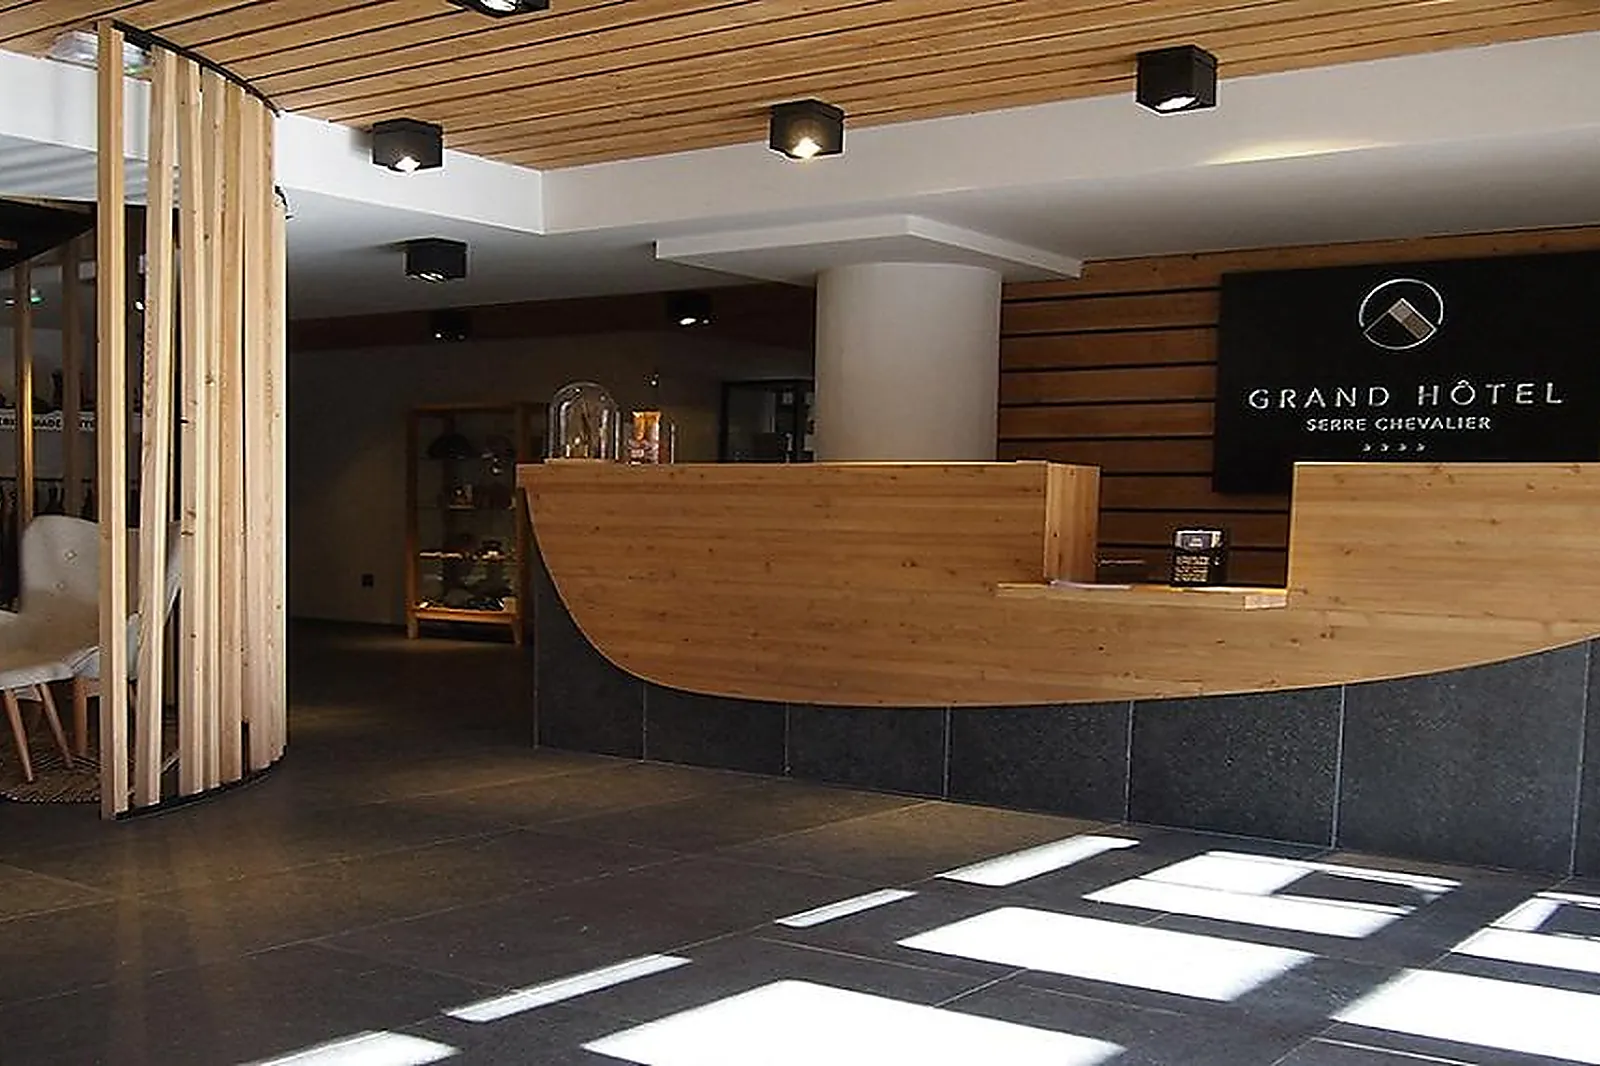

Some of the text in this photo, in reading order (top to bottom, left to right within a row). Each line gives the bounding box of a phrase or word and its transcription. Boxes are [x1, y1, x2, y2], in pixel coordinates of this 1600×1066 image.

[1248, 379, 1563, 409] GRAND HÔTEL
[1306, 416, 1491, 432] SERRE CHEVALIER
